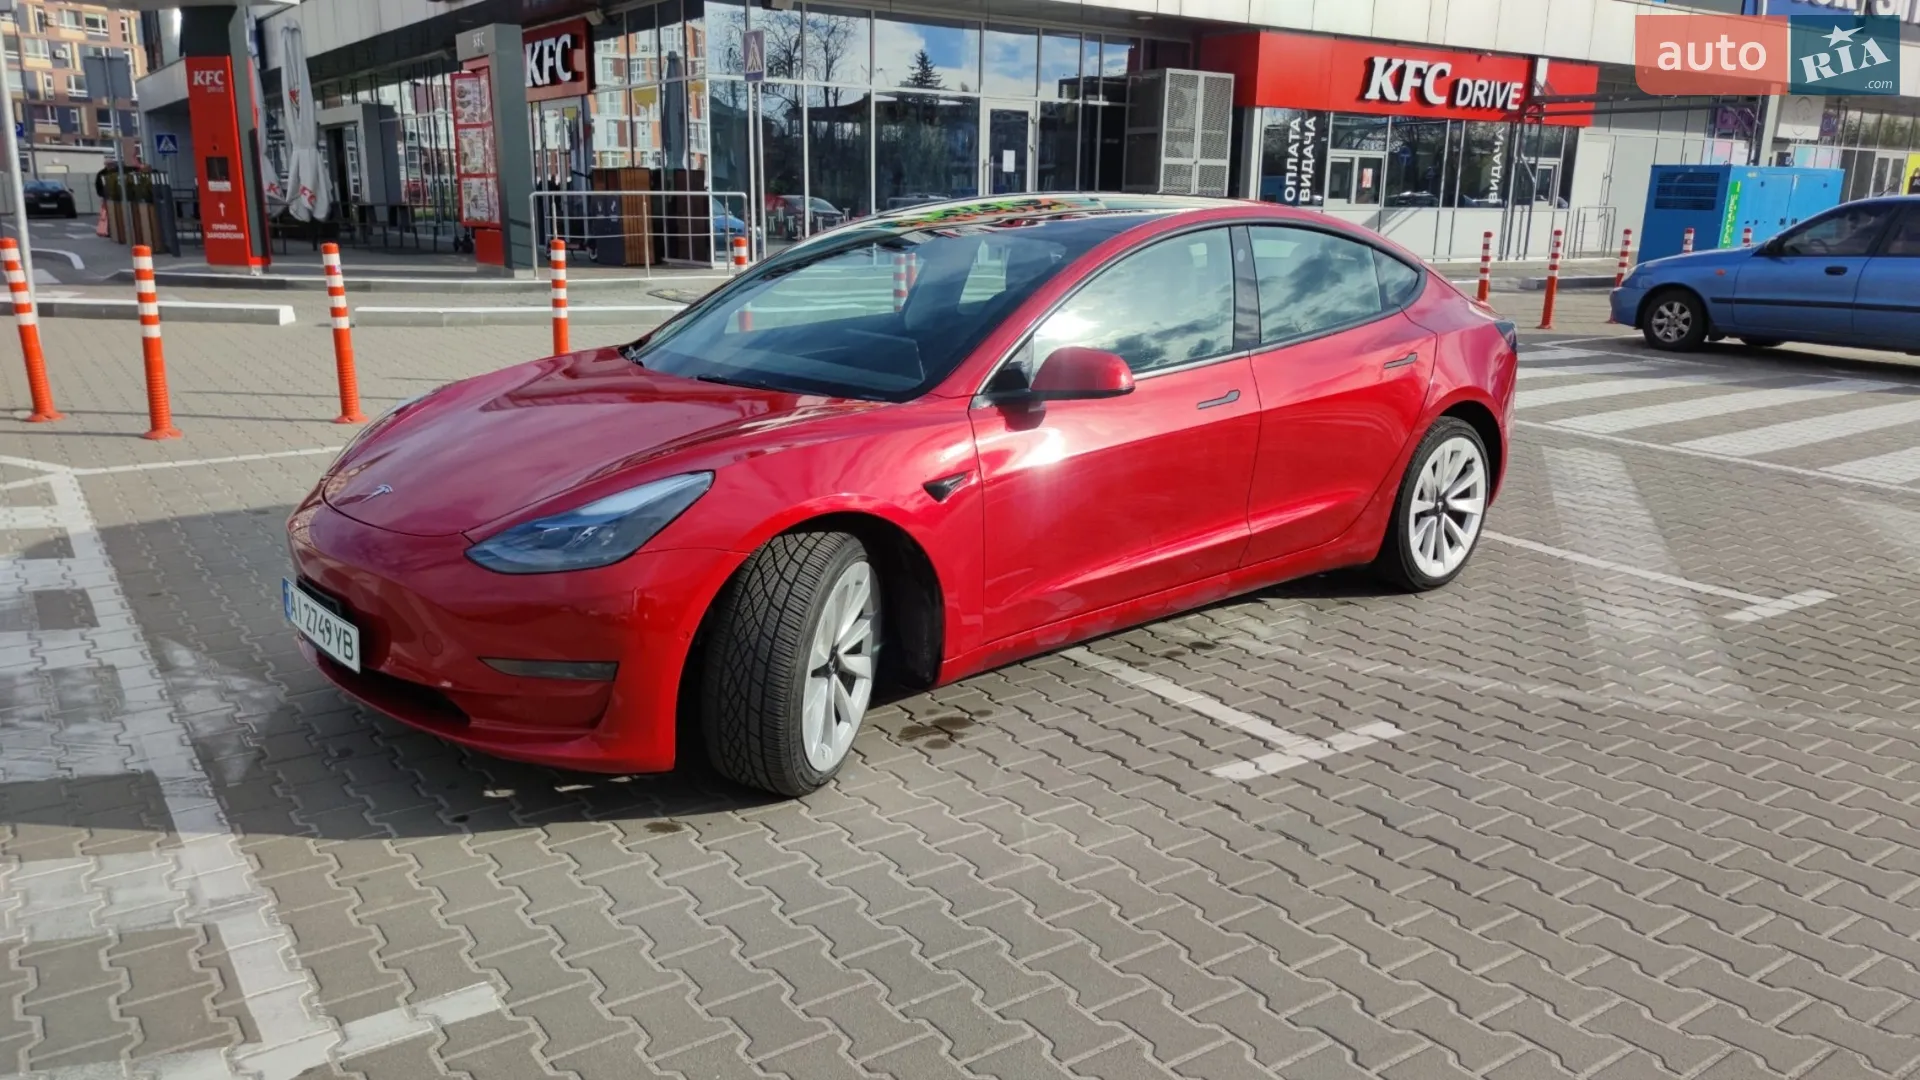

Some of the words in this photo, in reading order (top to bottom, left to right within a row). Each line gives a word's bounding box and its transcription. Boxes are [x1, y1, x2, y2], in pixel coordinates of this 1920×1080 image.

[192, 69, 225, 86] KFC
[525, 33, 572, 88] KFC
[1365, 56, 1452, 104] KFC
[1455, 78, 1524, 110] DRIVE
[1284, 116, 1302, 202] ОПЛАТА
[1299, 116, 1317, 202] ВИДАЧА
[1488, 127, 1505, 204] ВИДАЧА
[290, 591, 303, 624] AI
[303, 603, 333, 647] 2749
[334, 622, 354, 662] YB
